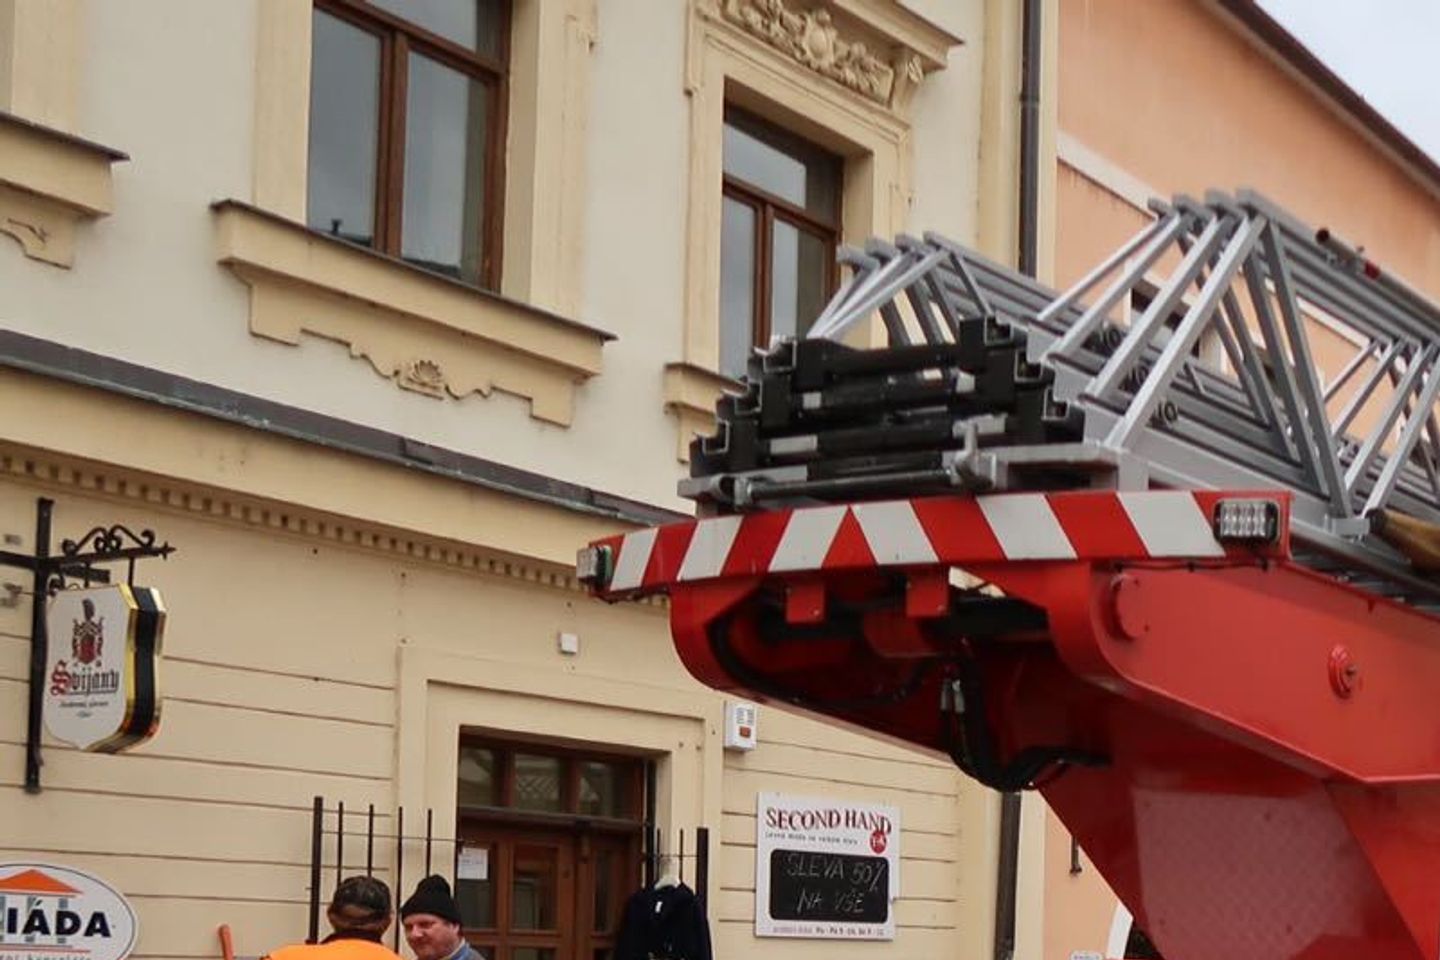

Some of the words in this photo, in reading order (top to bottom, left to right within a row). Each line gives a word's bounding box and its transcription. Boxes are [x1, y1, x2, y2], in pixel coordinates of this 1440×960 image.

[766, 807, 841, 830] SECOND
[845, 808, 892, 835] HAND
[786, 853, 845, 879] SLEVA
